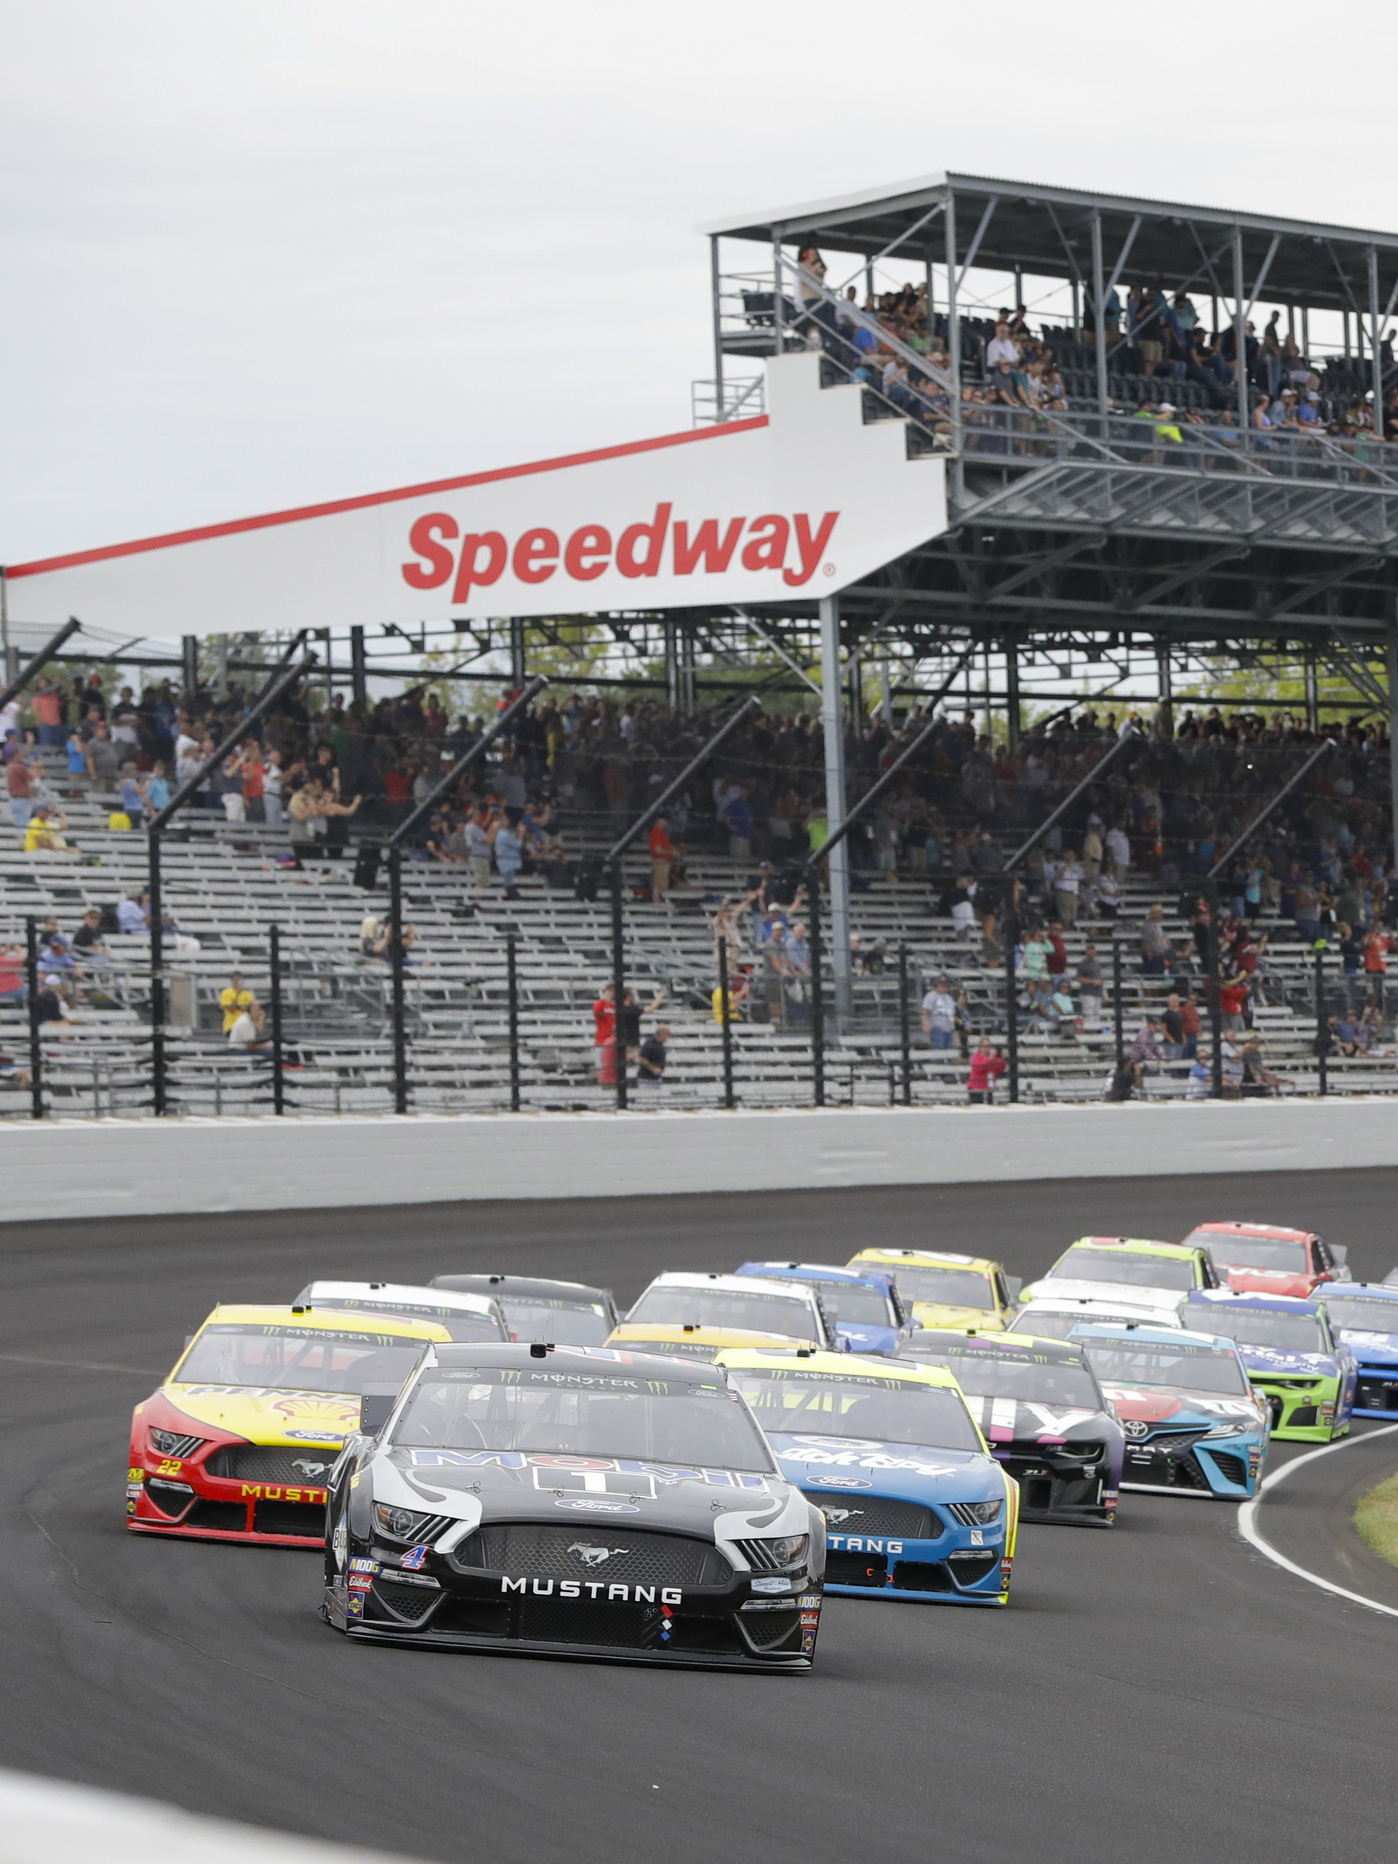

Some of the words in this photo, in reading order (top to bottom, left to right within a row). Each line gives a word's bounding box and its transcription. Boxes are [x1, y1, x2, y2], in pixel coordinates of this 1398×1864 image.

[401, 502, 841, 604] Speedway
[364, 1301, 431, 1313] MONSTER
[286, 1327, 370, 1342] MONSTER
[1122, 1340, 1180, 1352] MONSTER
[966, 1349, 1030, 1361] MONSTER
[530, 1373, 639, 1389] MONSTER
[795, 1372, 878, 1386] MONSTER
[299, 1429, 336, 1442] Ford
[156, 1459, 183, 1477] 22
[411, 1450, 770, 1492] Mobil
[819, 1476, 858, 1488] Ford
[570, 1498, 625, 1513] Ford
[399, 1545, 430, 1571] 4
[501, 1576, 683, 1606] MUSTANG
